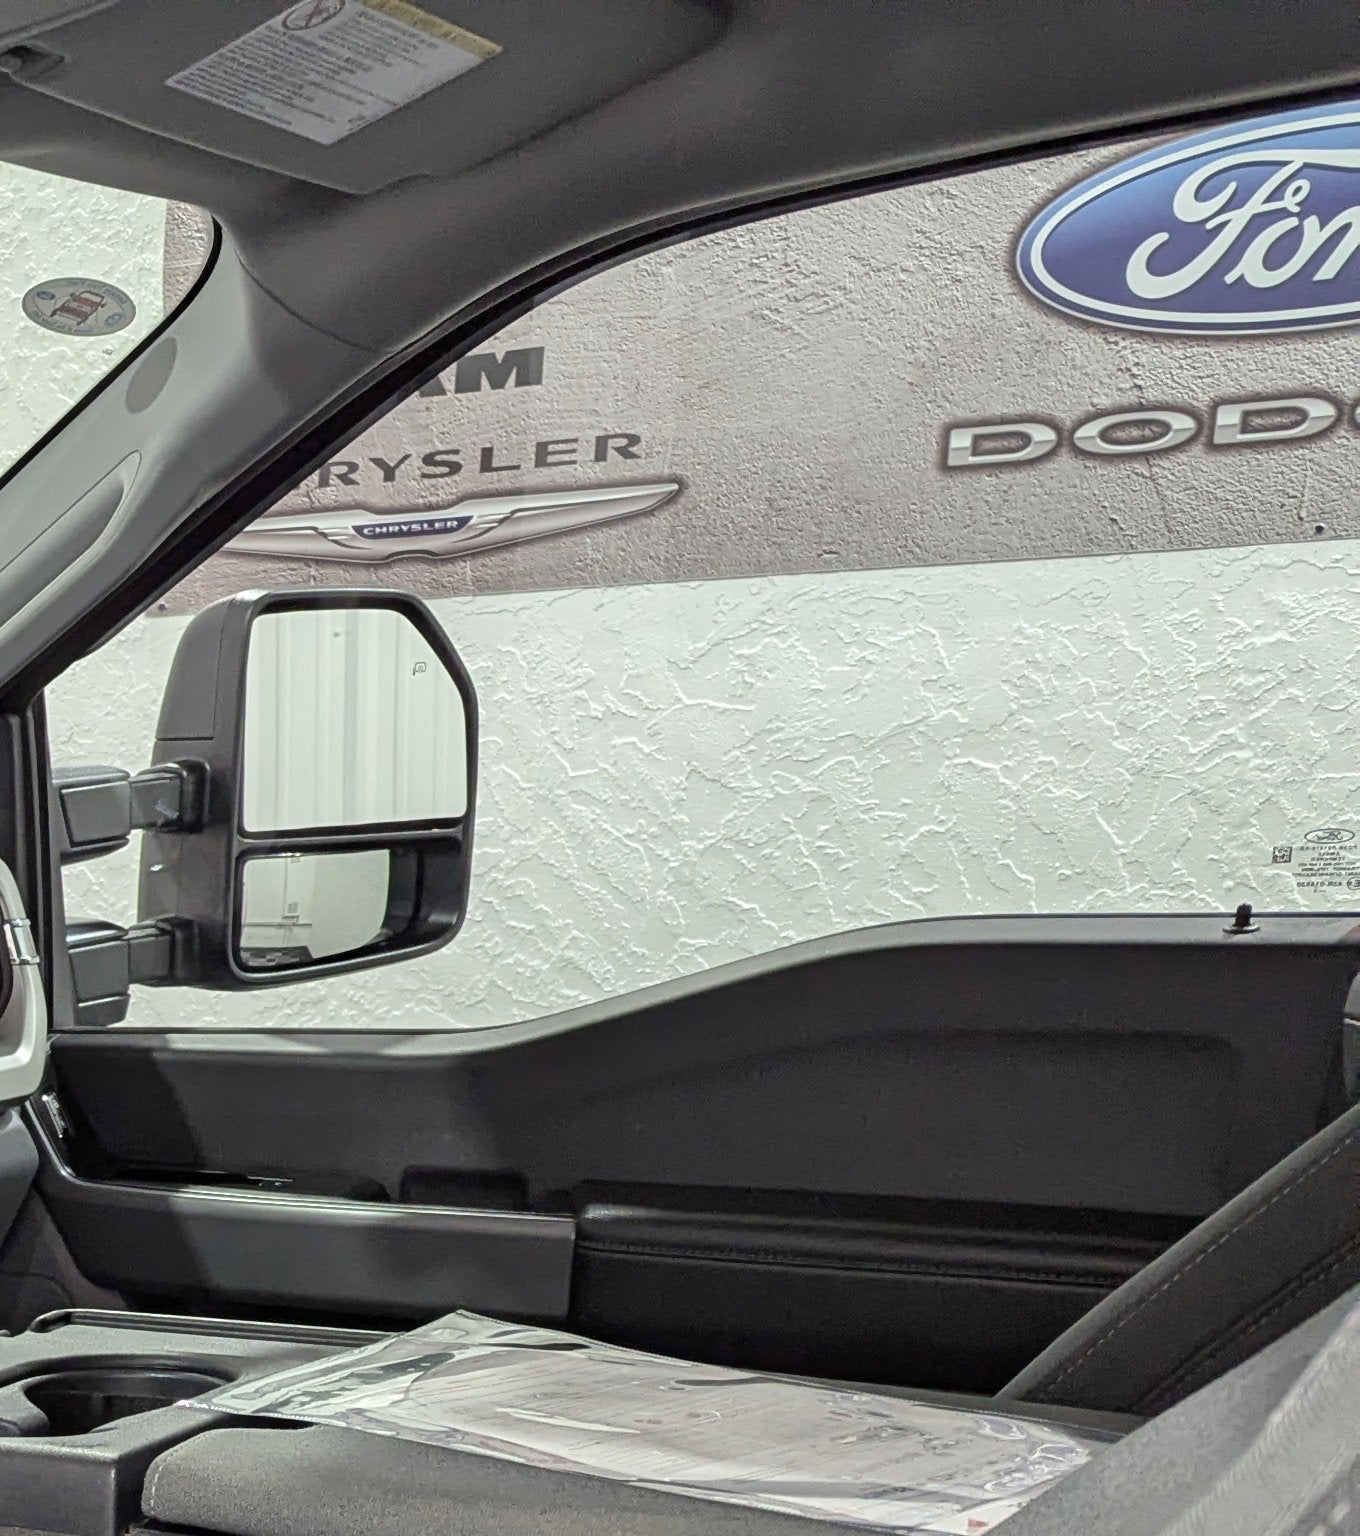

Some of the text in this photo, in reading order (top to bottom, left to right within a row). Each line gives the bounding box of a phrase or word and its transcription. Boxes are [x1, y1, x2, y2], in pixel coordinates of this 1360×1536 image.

[947, 397, 1360, 467] DOD
[317, 433, 642, 488] RYSLER
[363, 519, 459, 536] CHRYSLER
